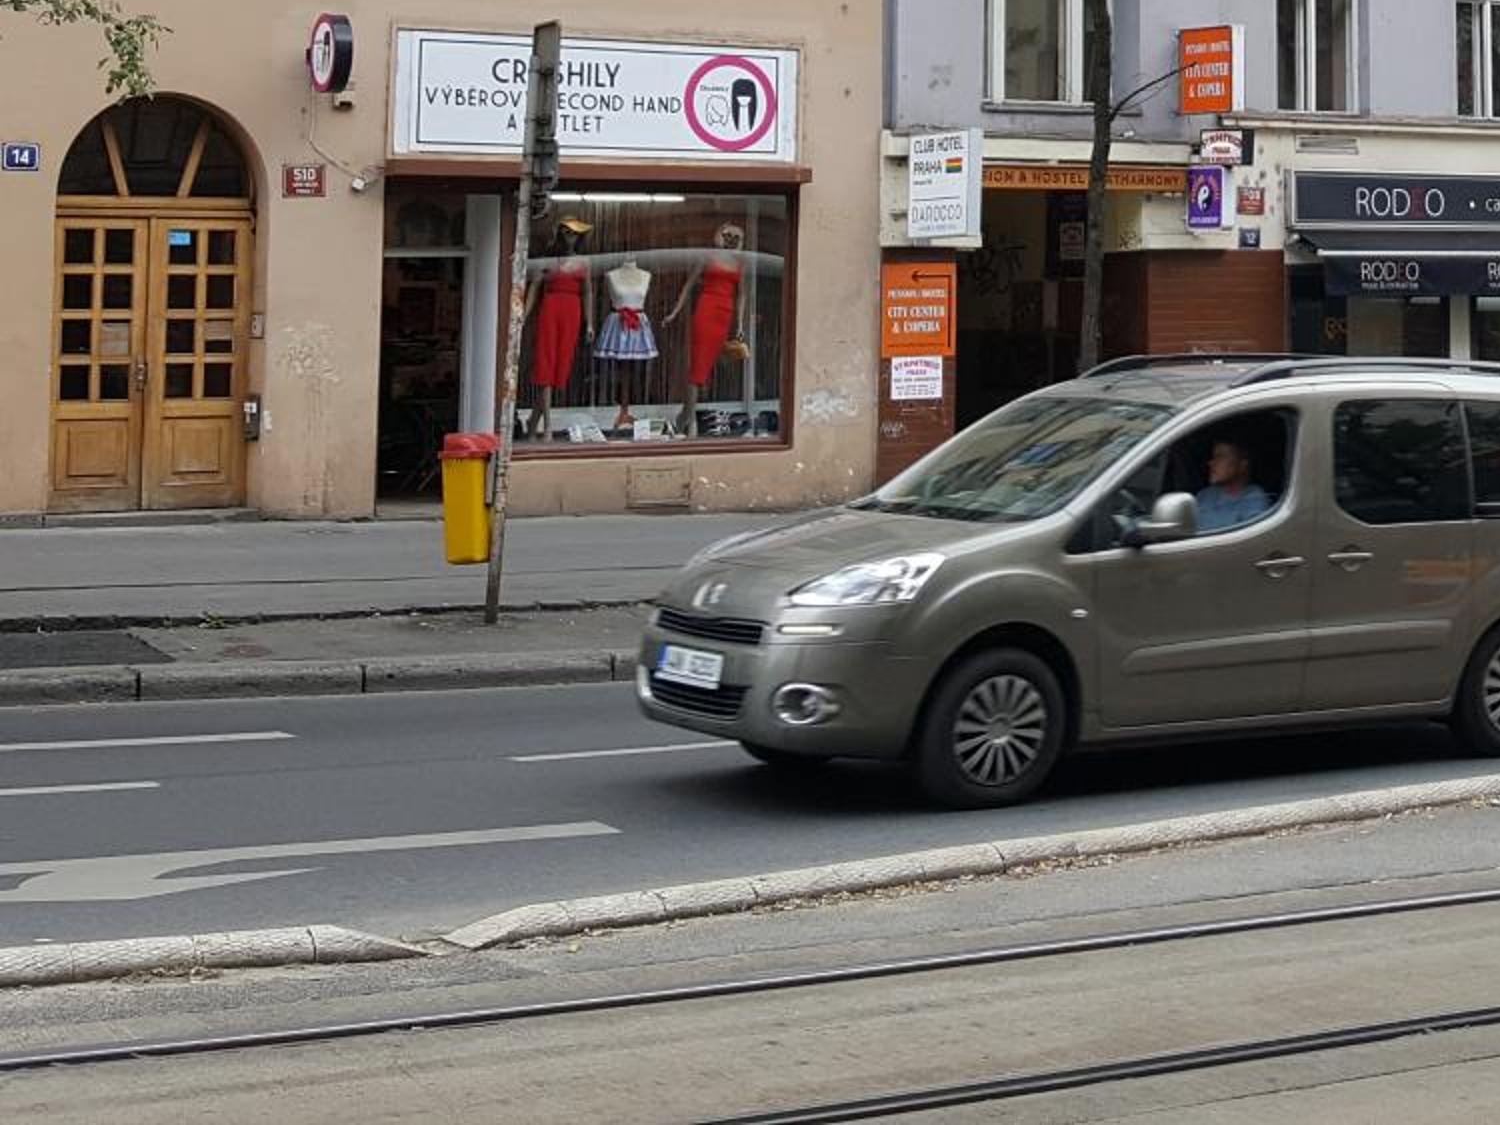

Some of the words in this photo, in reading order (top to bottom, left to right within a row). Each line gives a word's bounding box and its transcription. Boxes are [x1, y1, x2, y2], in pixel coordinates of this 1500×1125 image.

[491, 58, 621, 88] CRSHILY
[557, 92, 625, 113] ECOND
[634, 95, 682, 114] HAND
[506, 113, 518, 130] A
[937, 135, 966, 152] HOTEL
[11, 148, 29, 165] 14
[293, 168, 317, 181] 510
[913, 159, 943, 175] PRAHA
[1033, 171, 1086, 184] HOSTEL
[1355, 186, 1446, 218] RODEO
[1361, 261, 1419, 281] RODEO
